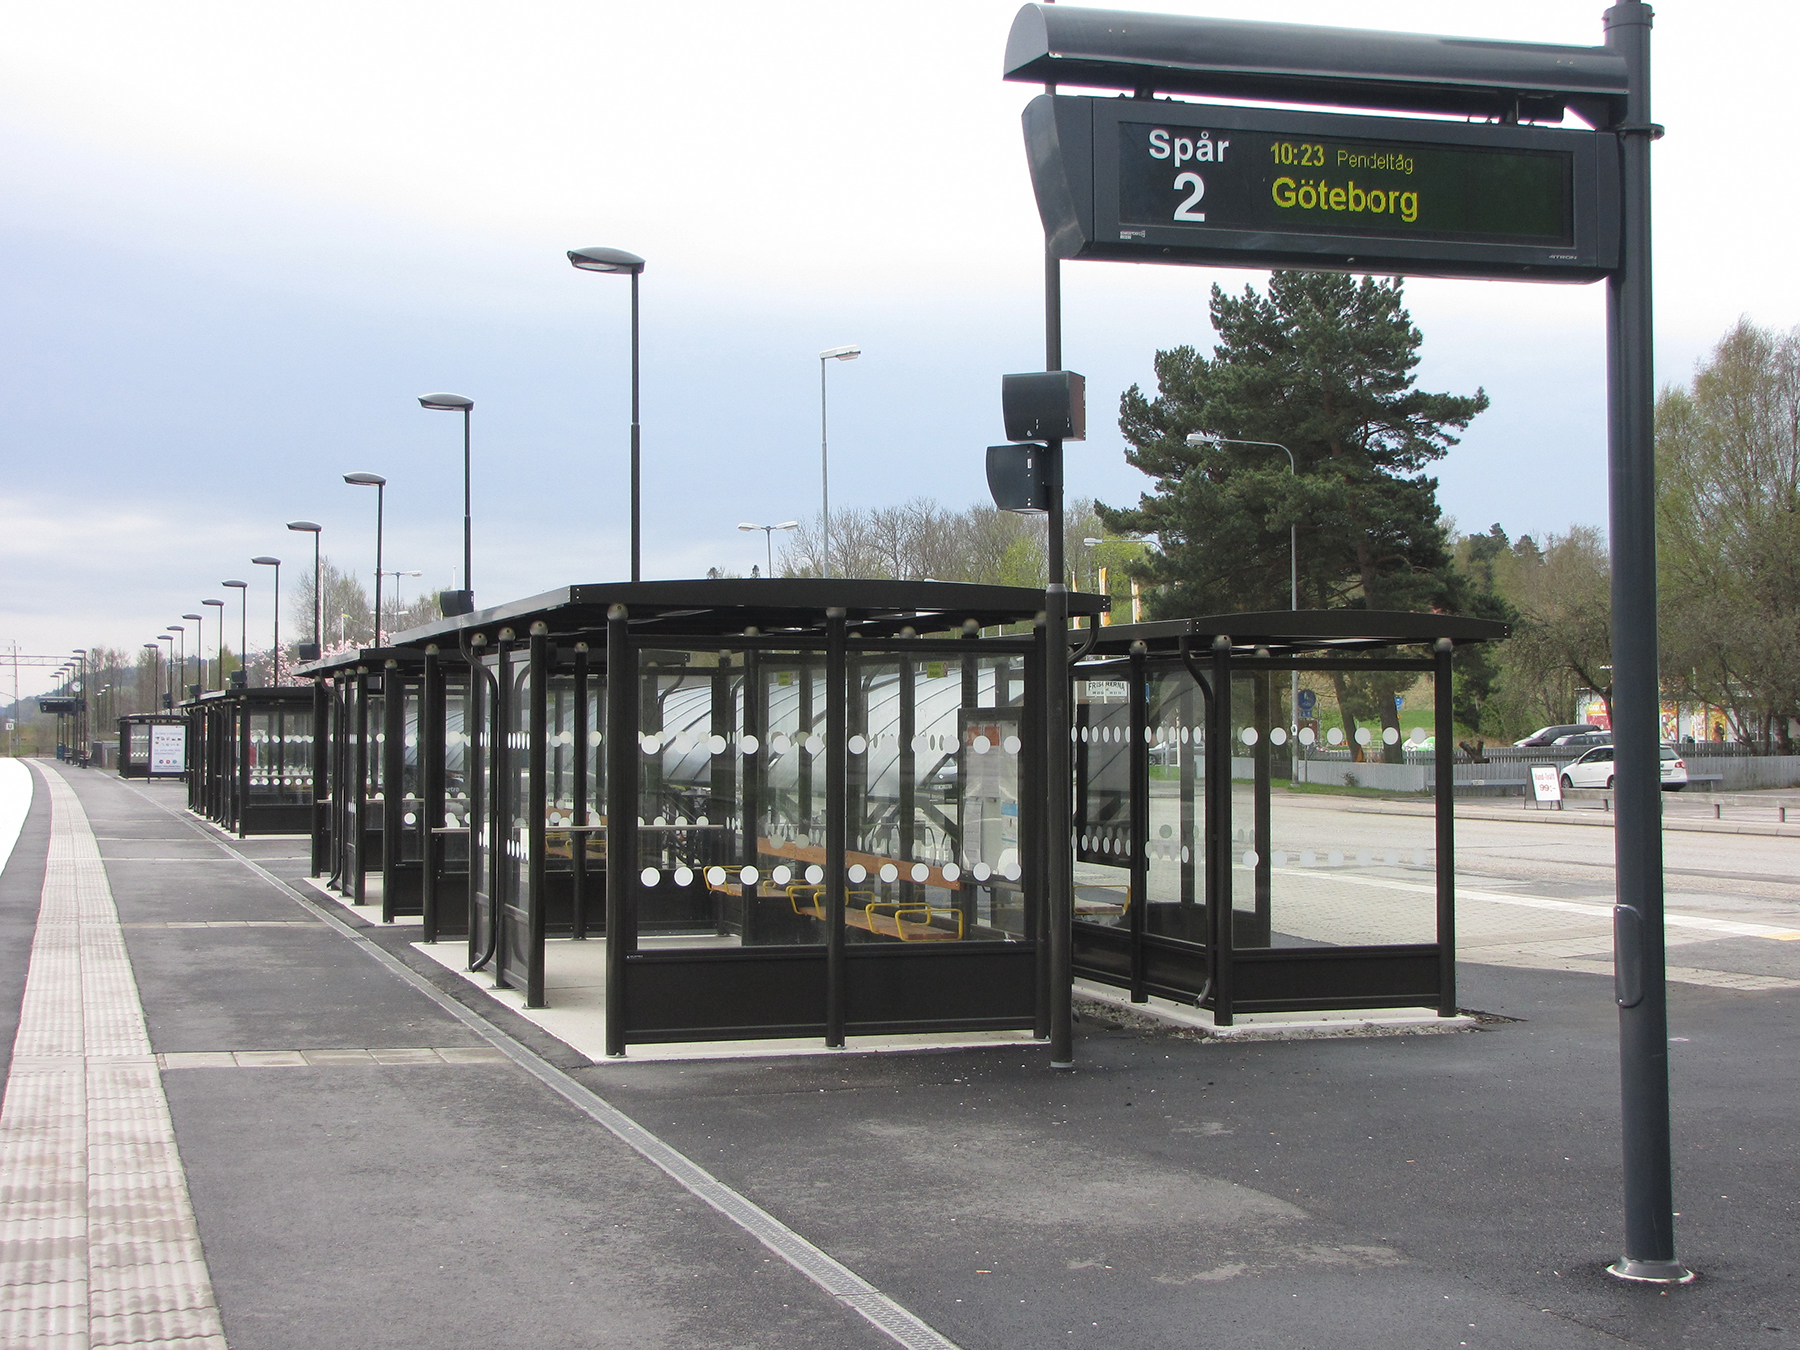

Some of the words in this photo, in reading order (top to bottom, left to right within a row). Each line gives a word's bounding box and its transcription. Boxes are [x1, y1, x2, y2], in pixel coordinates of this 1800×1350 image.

[1148, 129, 1230, 168] Spår
[1270, 142, 1326, 167] 10:23
[1337, 150, 1415, 175] Pendeltåg
[1173, 171, 1206, 222] 2
[1271, 176, 1419, 223] Göteborg
